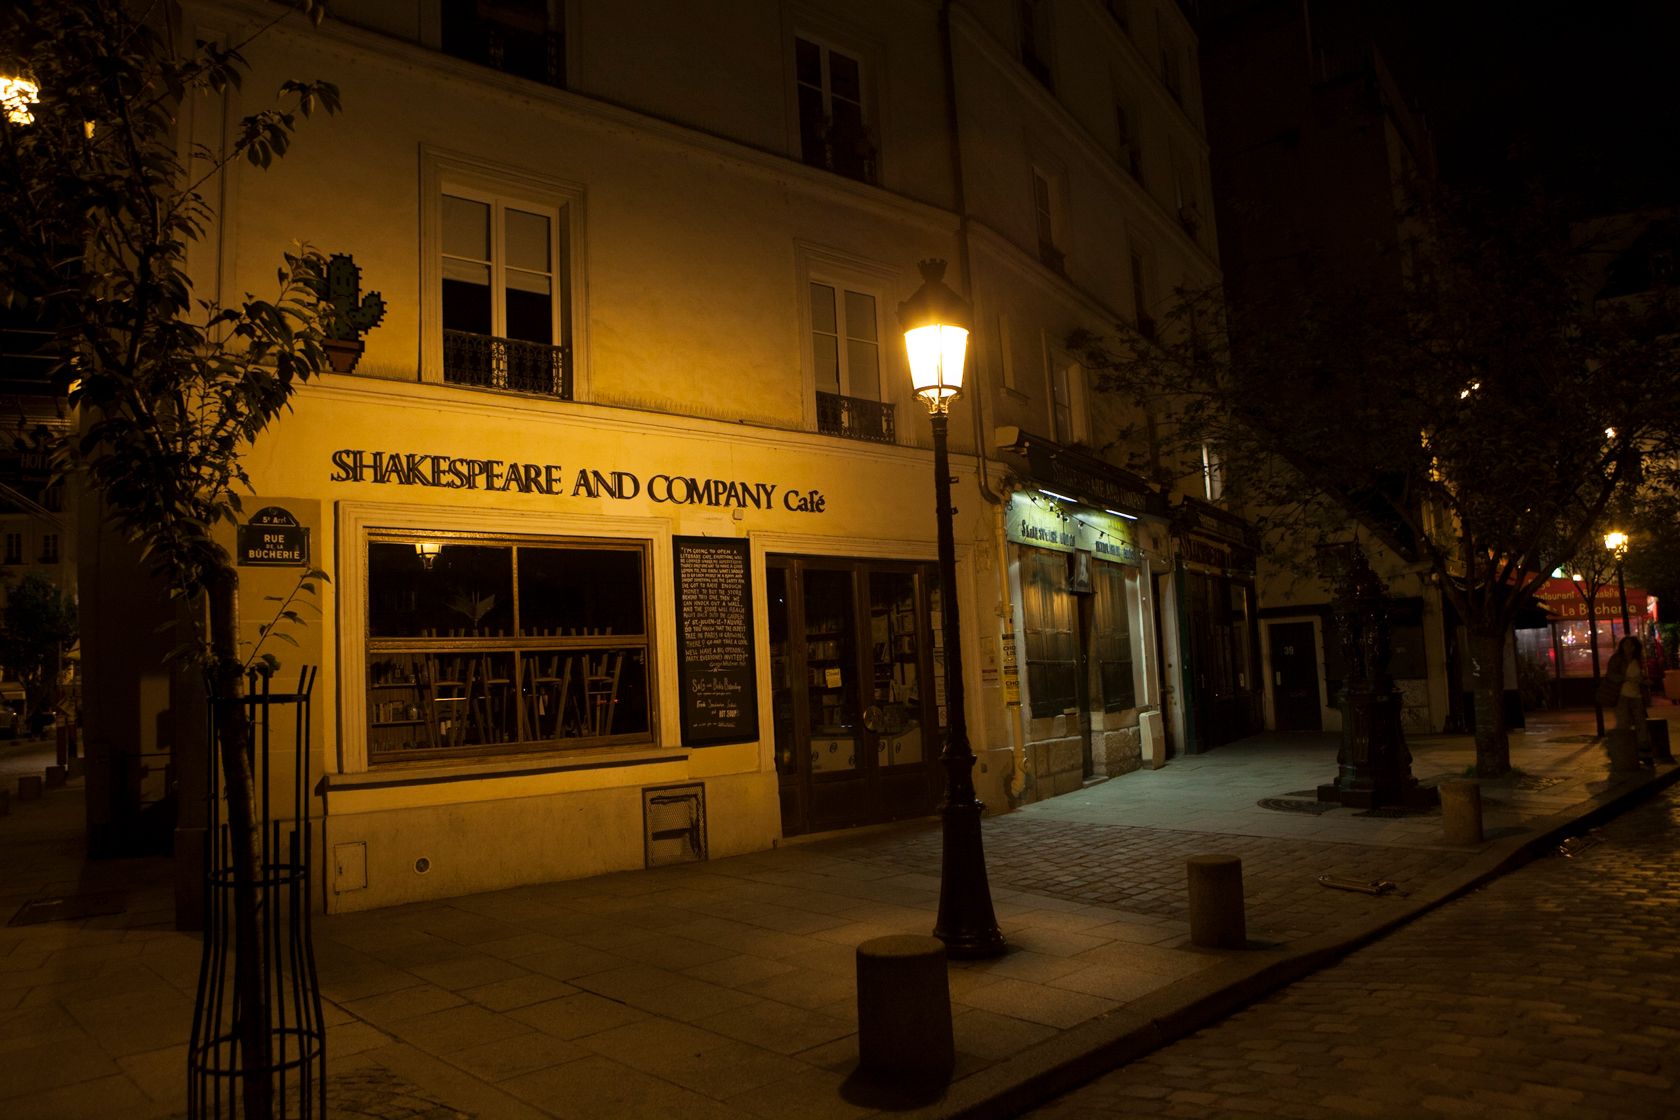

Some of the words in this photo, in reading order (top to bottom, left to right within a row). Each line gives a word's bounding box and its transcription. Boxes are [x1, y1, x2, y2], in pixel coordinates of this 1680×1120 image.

[330, 449, 563, 495] SHAKESPEARE
[571, 468, 640, 500] AND
[647, 474, 777, 510] COMPANY
[783, 489, 826, 514] Café
[263, 533, 285, 543] RUE
[1561, 604, 1575, 617] La
